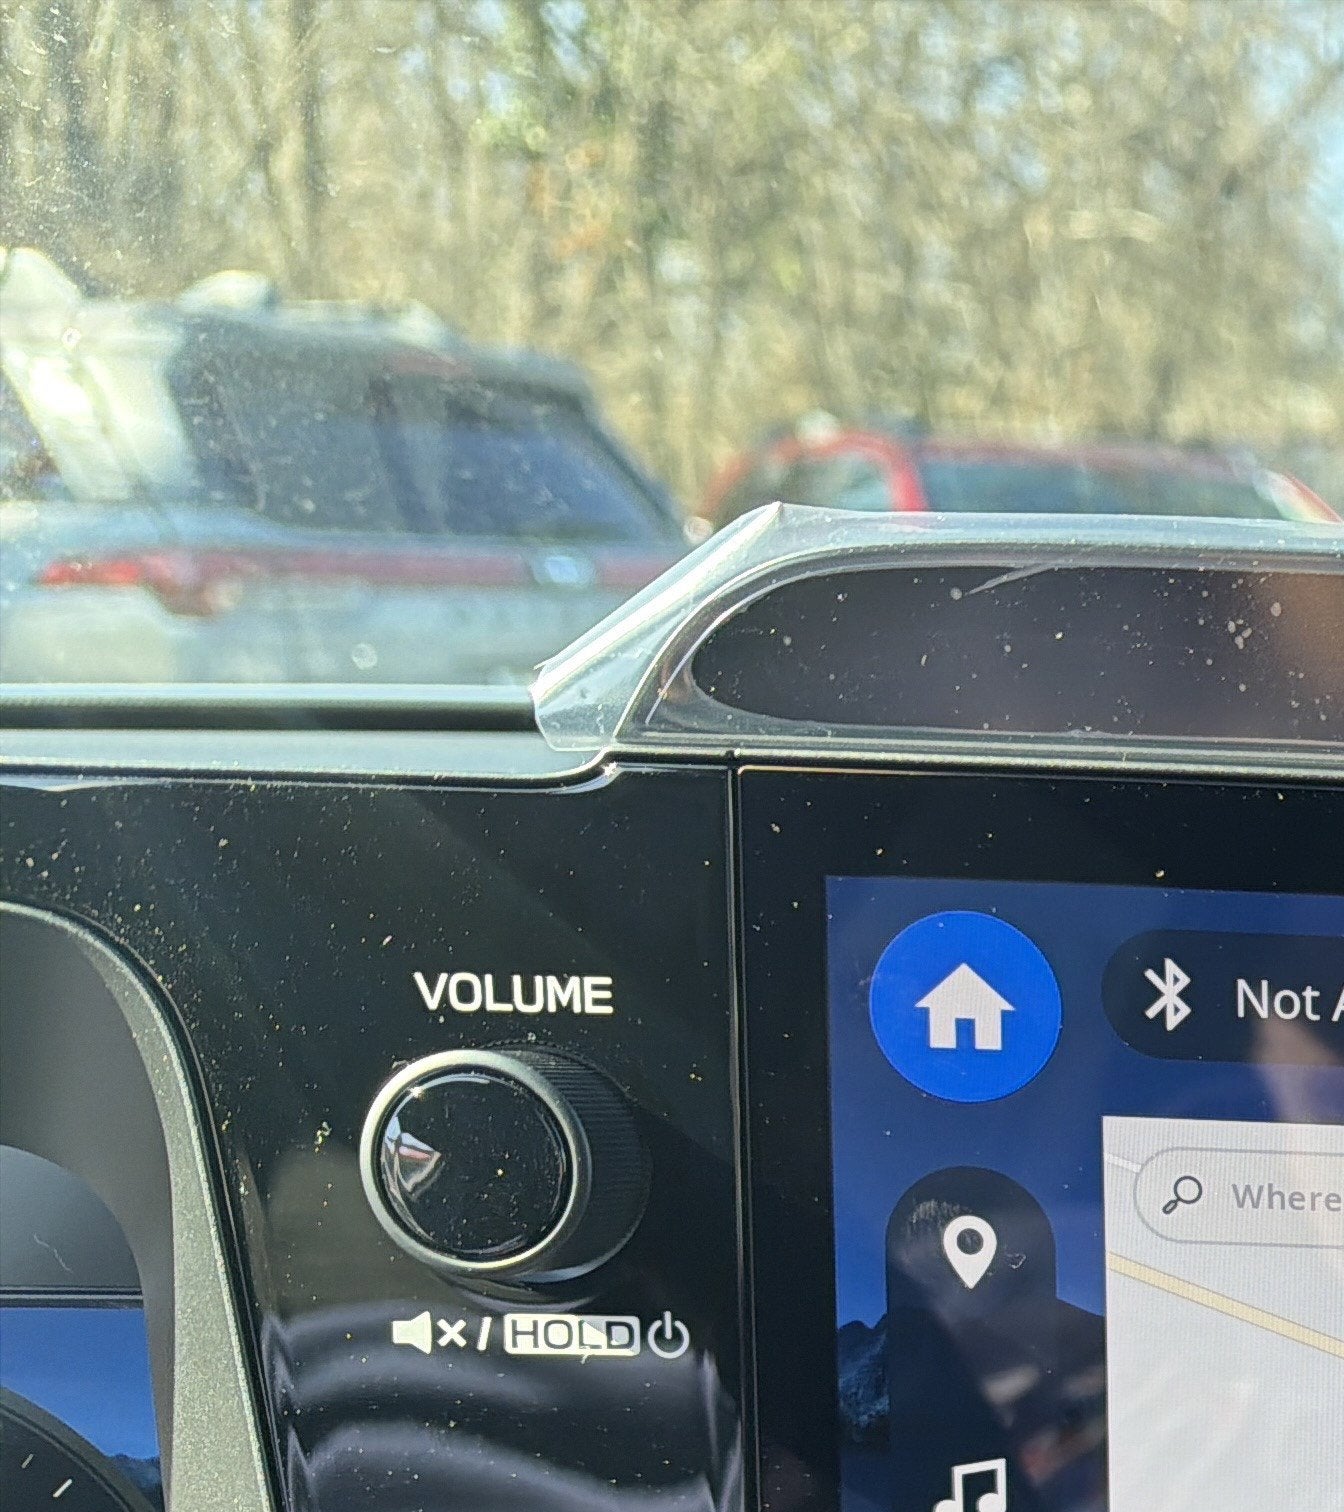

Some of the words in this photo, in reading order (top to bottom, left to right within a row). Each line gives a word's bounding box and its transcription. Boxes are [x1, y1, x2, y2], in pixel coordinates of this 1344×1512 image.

[412, 971, 614, 1014] VOLUME
[1236, 978, 1320, 1021] Not
[1231, 1183, 1342, 1212] Where
[511, 1319, 634, 1350] HOLD
